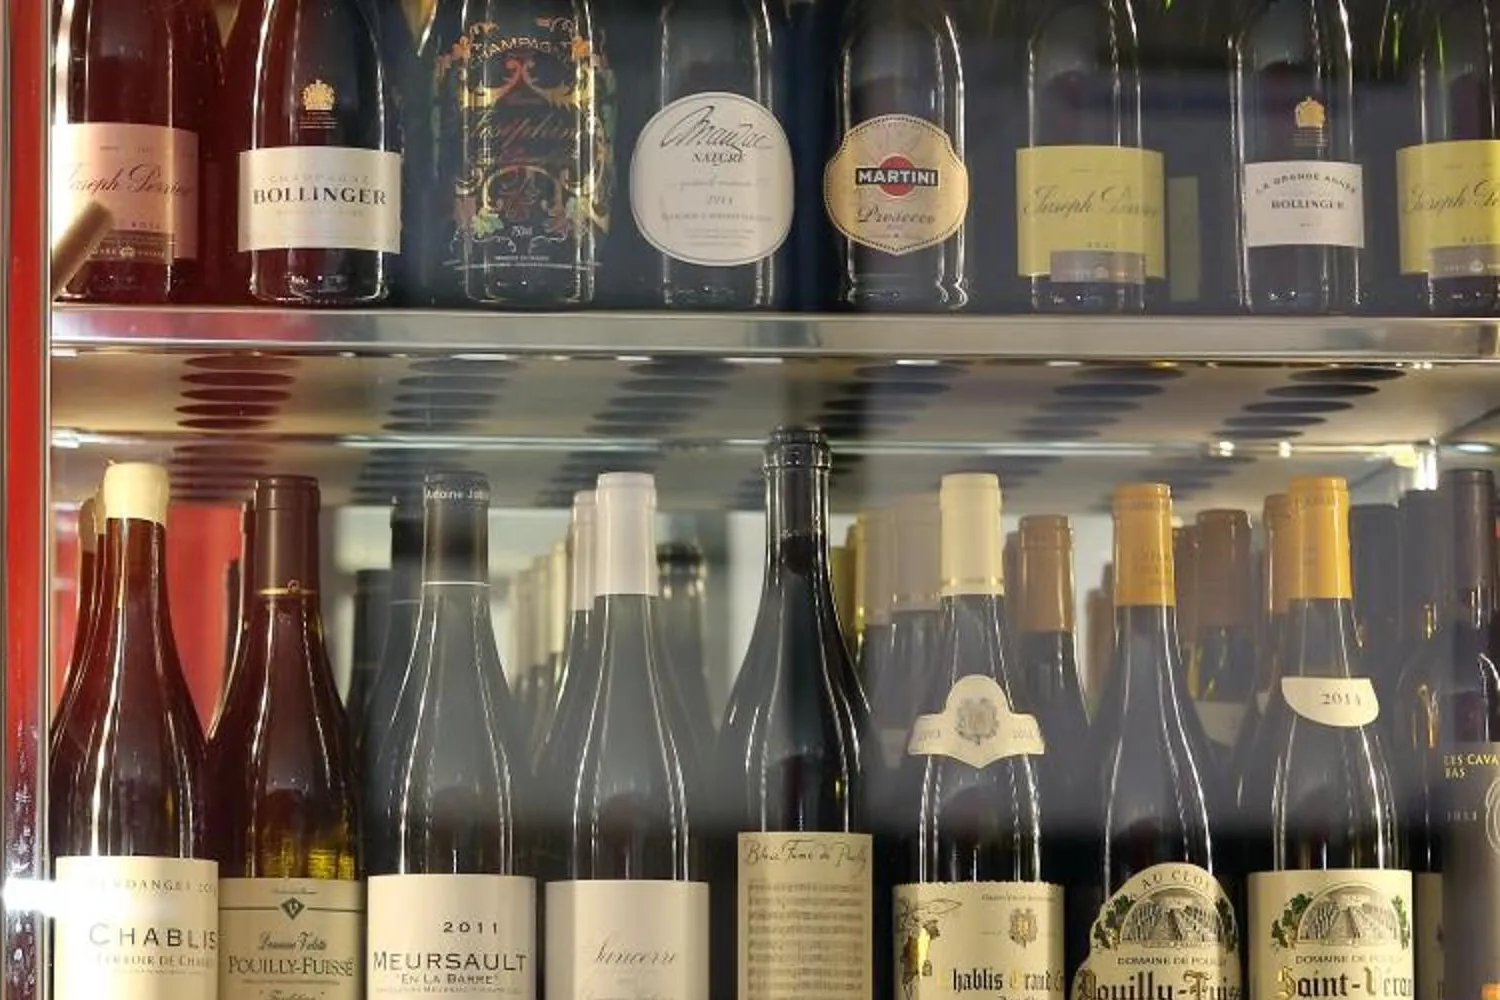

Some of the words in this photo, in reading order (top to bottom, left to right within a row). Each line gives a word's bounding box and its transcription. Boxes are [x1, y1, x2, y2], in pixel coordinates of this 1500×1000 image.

[857, 169, 937, 185] MARTINI
[252, 186, 387, 206] BOLLINGER
[855, 203, 936, 225] Prosecco
[88, 920, 219, 952] CHABLIS
[441, 920, 499, 936] 2011
[227, 954, 359, 977] POUILLY-FUISSÉ
[372, 950, 529, 973] MEURSAULT
